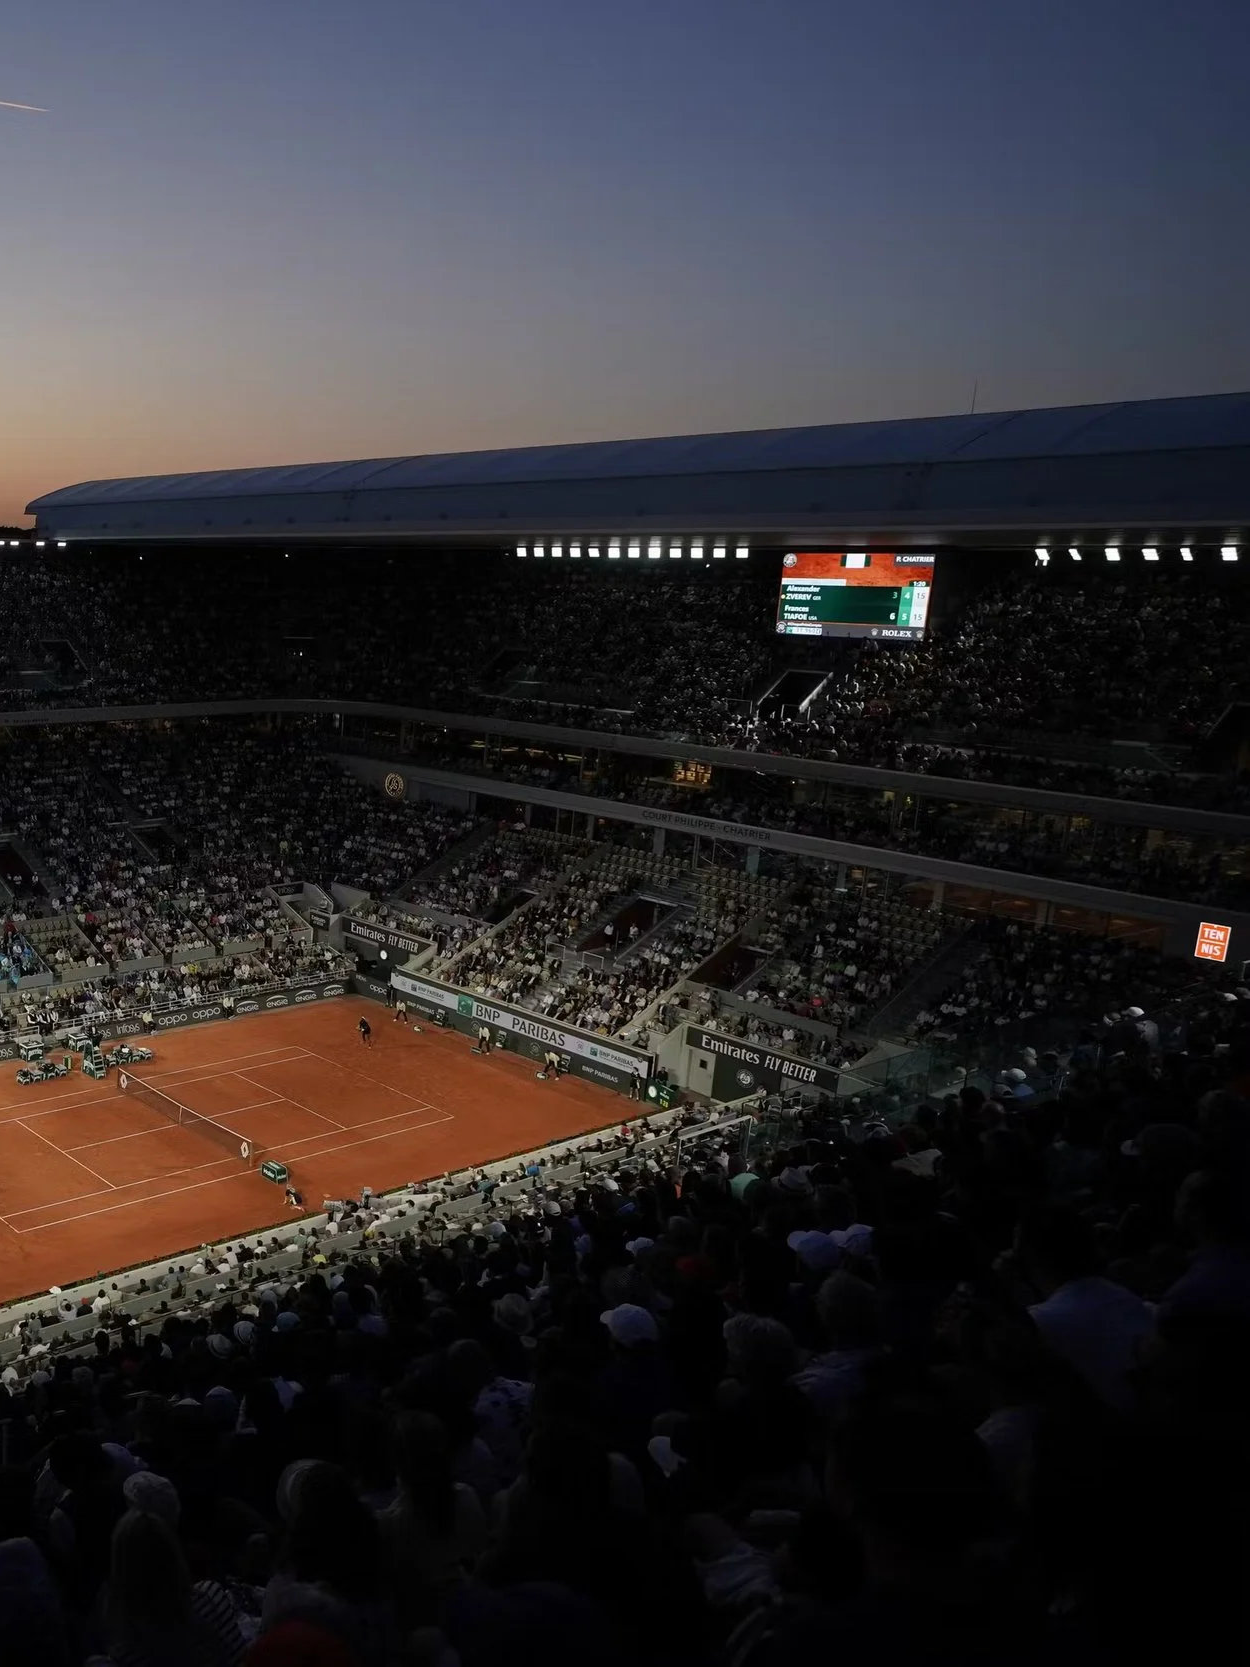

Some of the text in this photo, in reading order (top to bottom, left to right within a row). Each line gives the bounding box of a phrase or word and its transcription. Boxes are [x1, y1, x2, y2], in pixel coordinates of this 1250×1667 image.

[786, 584, 821, 592] Alexander
[892, 591, 898, 599] 3
[916, 592, 926, 600] 15
[784, 604, 810, 612] Frances
[783, 613, 808, 621] TIAFOE
[889, 612, 896, 620] 6
[881, 629, 912, 638] ROLEX
[642, 810, 671, 822] COURT
[350, 921, 419, 953] Emirates FLY BETTER
[1203, 927, 1225, 941] TEN
[1200, 943, 1221, 956] NIS
[192, 1007, 221, 1019] oppo
[158, 1013, 188, 1026] oppo
[476, 1004, 565, 1046] BNP PARIBAS
[116, 1023, 141, 1035] Infosys
[701, 1034, 760, 1065] Emirates
[764, 1055, 781, 1072] FLY
[781, 1061, 817, 1083] BETTER
[582, 1065, 619, 1083] BNP PARIBAS
